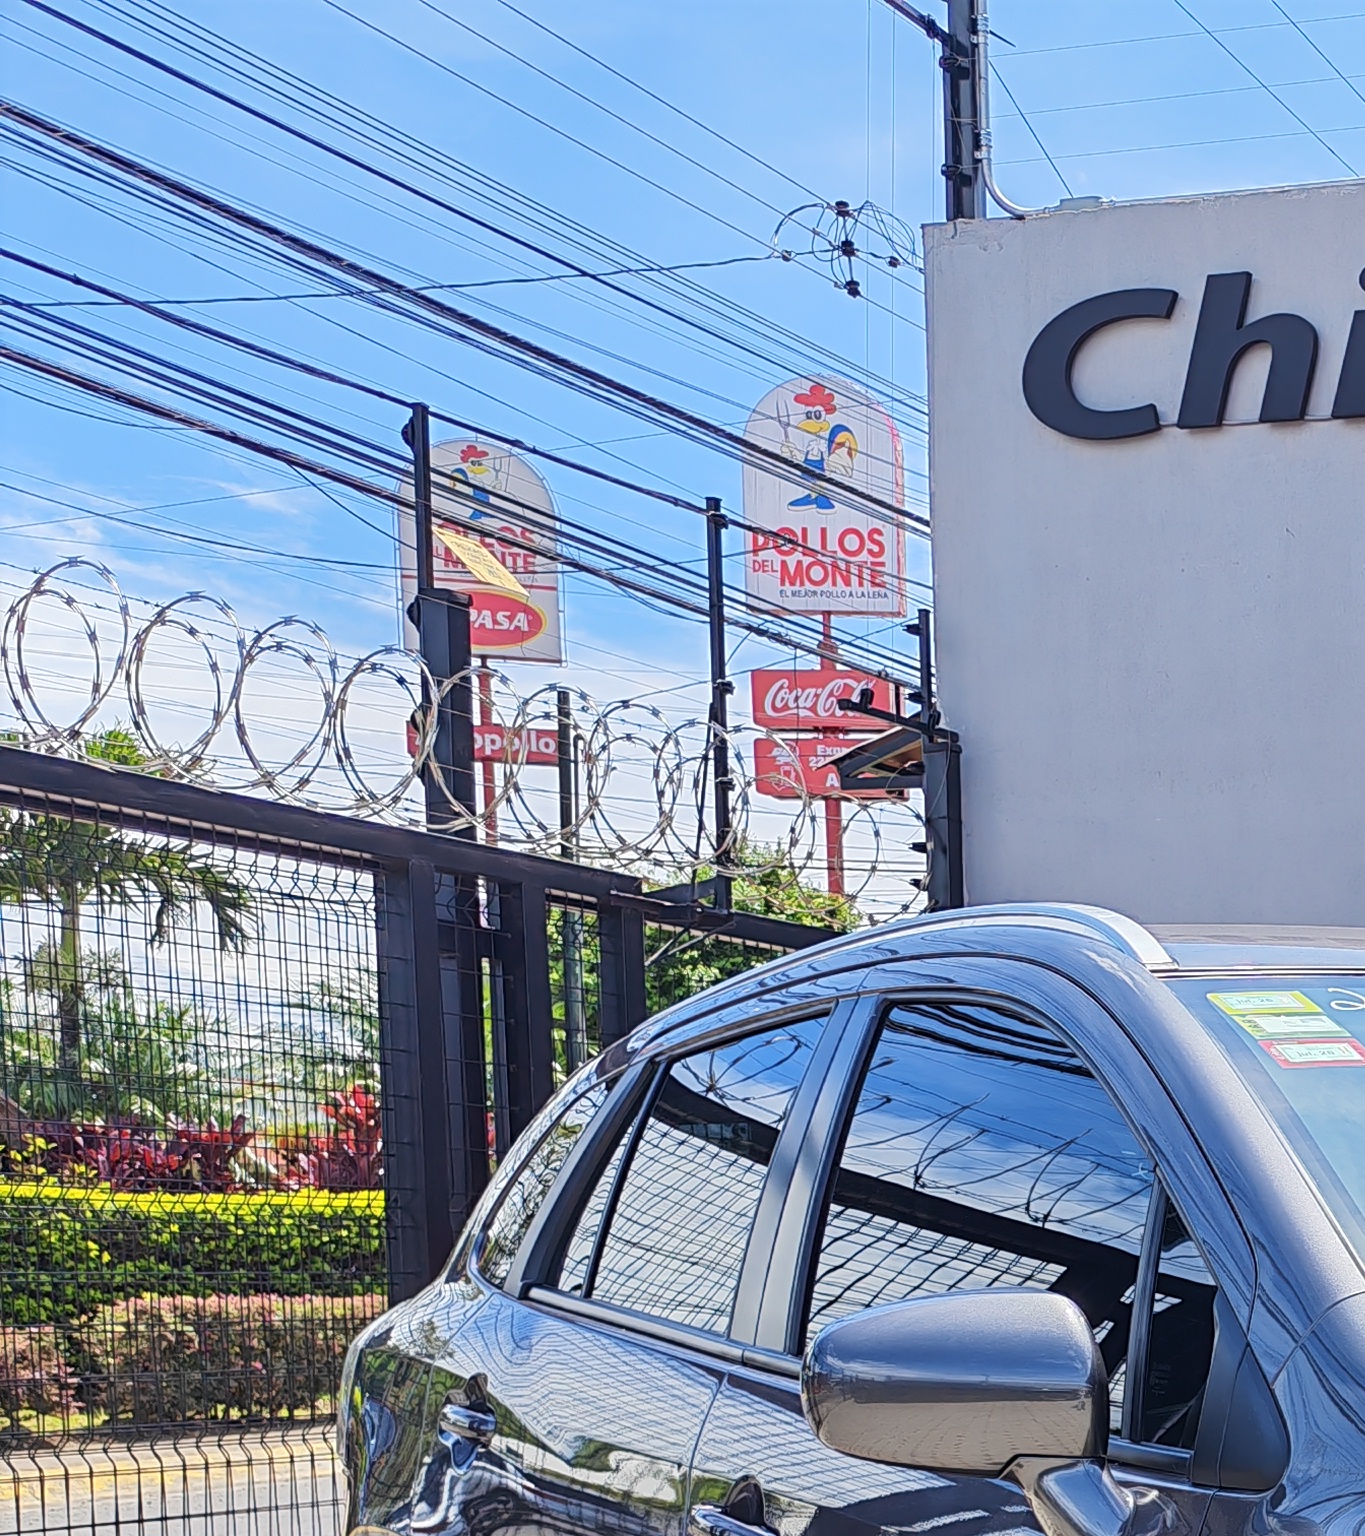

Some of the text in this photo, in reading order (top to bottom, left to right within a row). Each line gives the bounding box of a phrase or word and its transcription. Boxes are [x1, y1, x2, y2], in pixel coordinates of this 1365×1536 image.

[752, 526, 886, 559] POLLOS
[752, 559, 887, 588] DEL MONTE
[779, 588, 790, 599] EL
[791, 588, 819, 599] MEJOR
[820, 588, 847, 599] POLLO
[848, 589, 856, 599] A
[856, 589, 867, 599] LA
[764, 678, 875, 718] Coca-C
